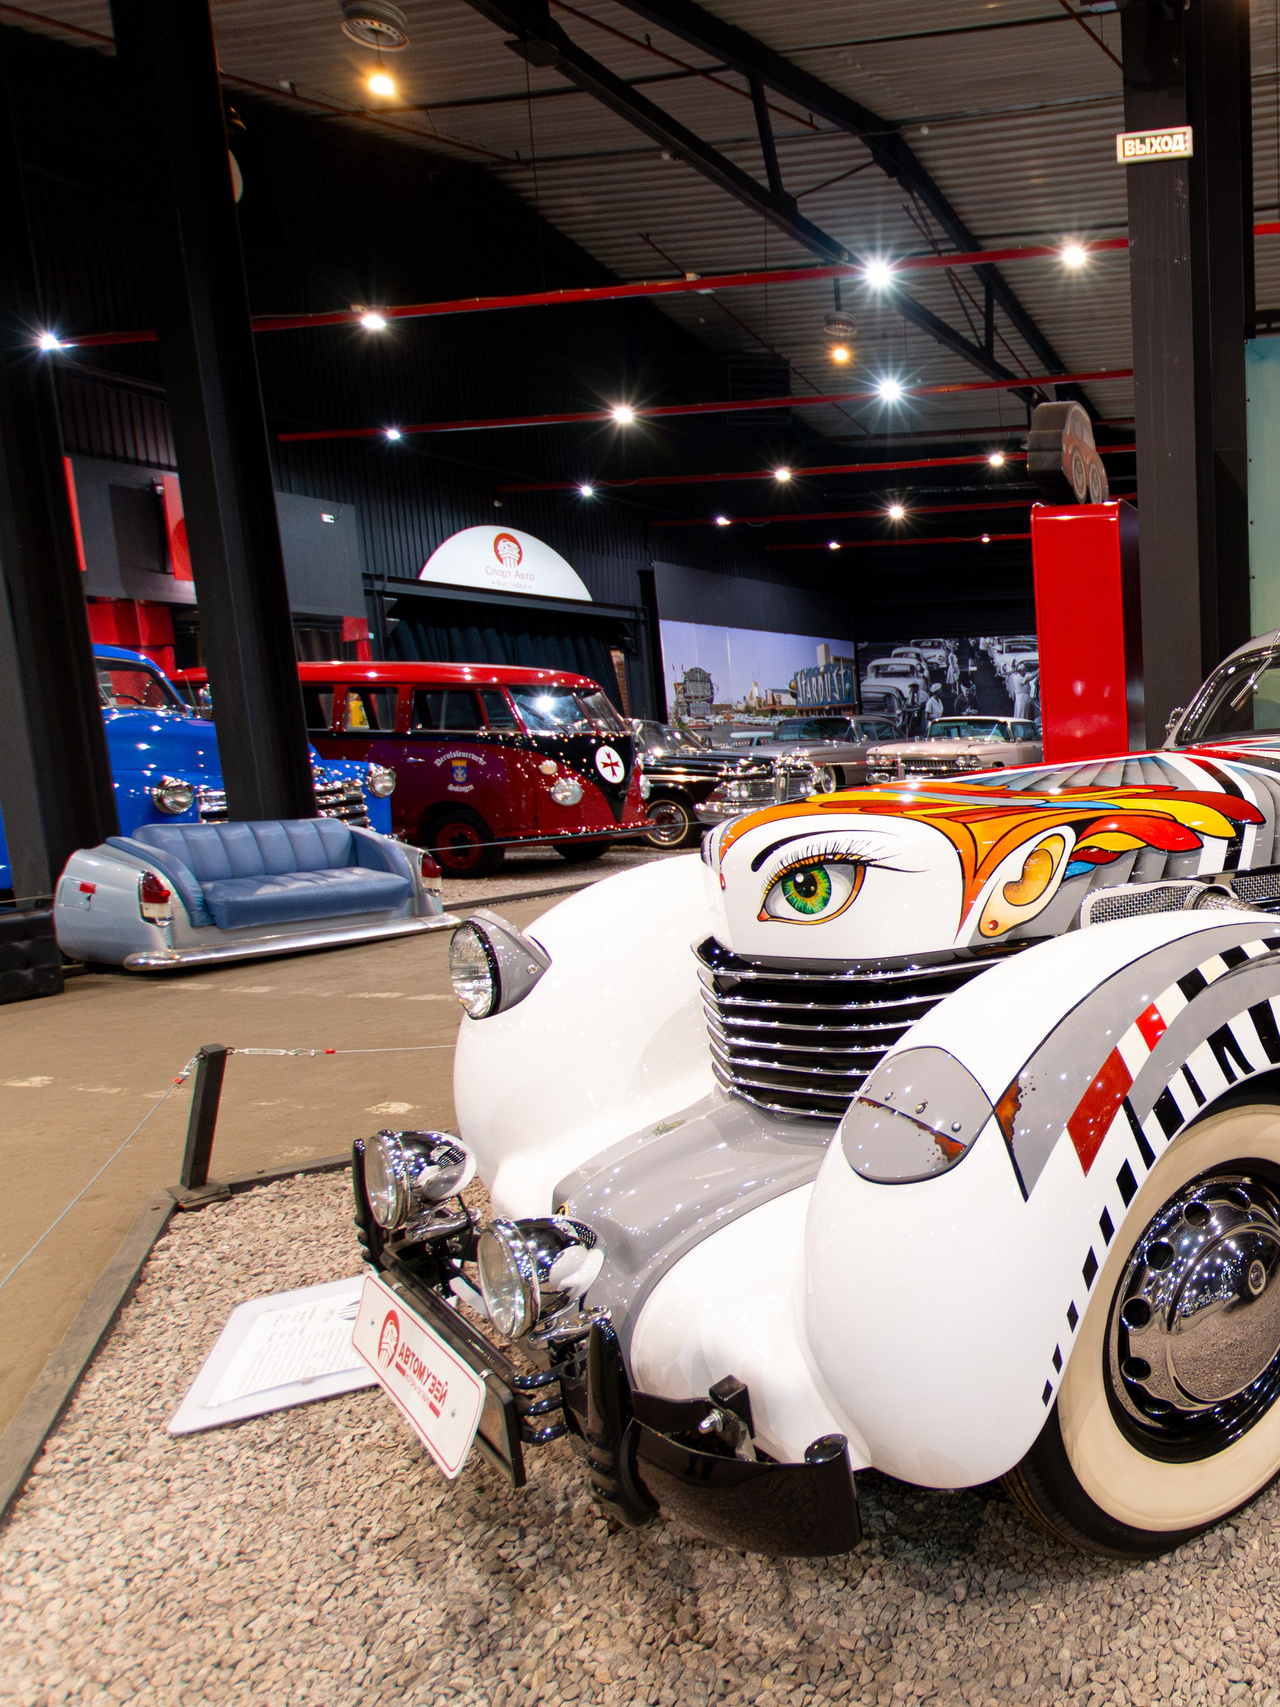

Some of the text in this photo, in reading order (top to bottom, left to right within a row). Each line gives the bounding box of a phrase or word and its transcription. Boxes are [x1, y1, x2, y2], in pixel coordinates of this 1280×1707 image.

[1124, 133, 1185, 157] ВЫХОД
[485, 565, 535, 581] Спорт Авто
[398, 1341, 449, 1408] АВТОМУЗЕЙ
